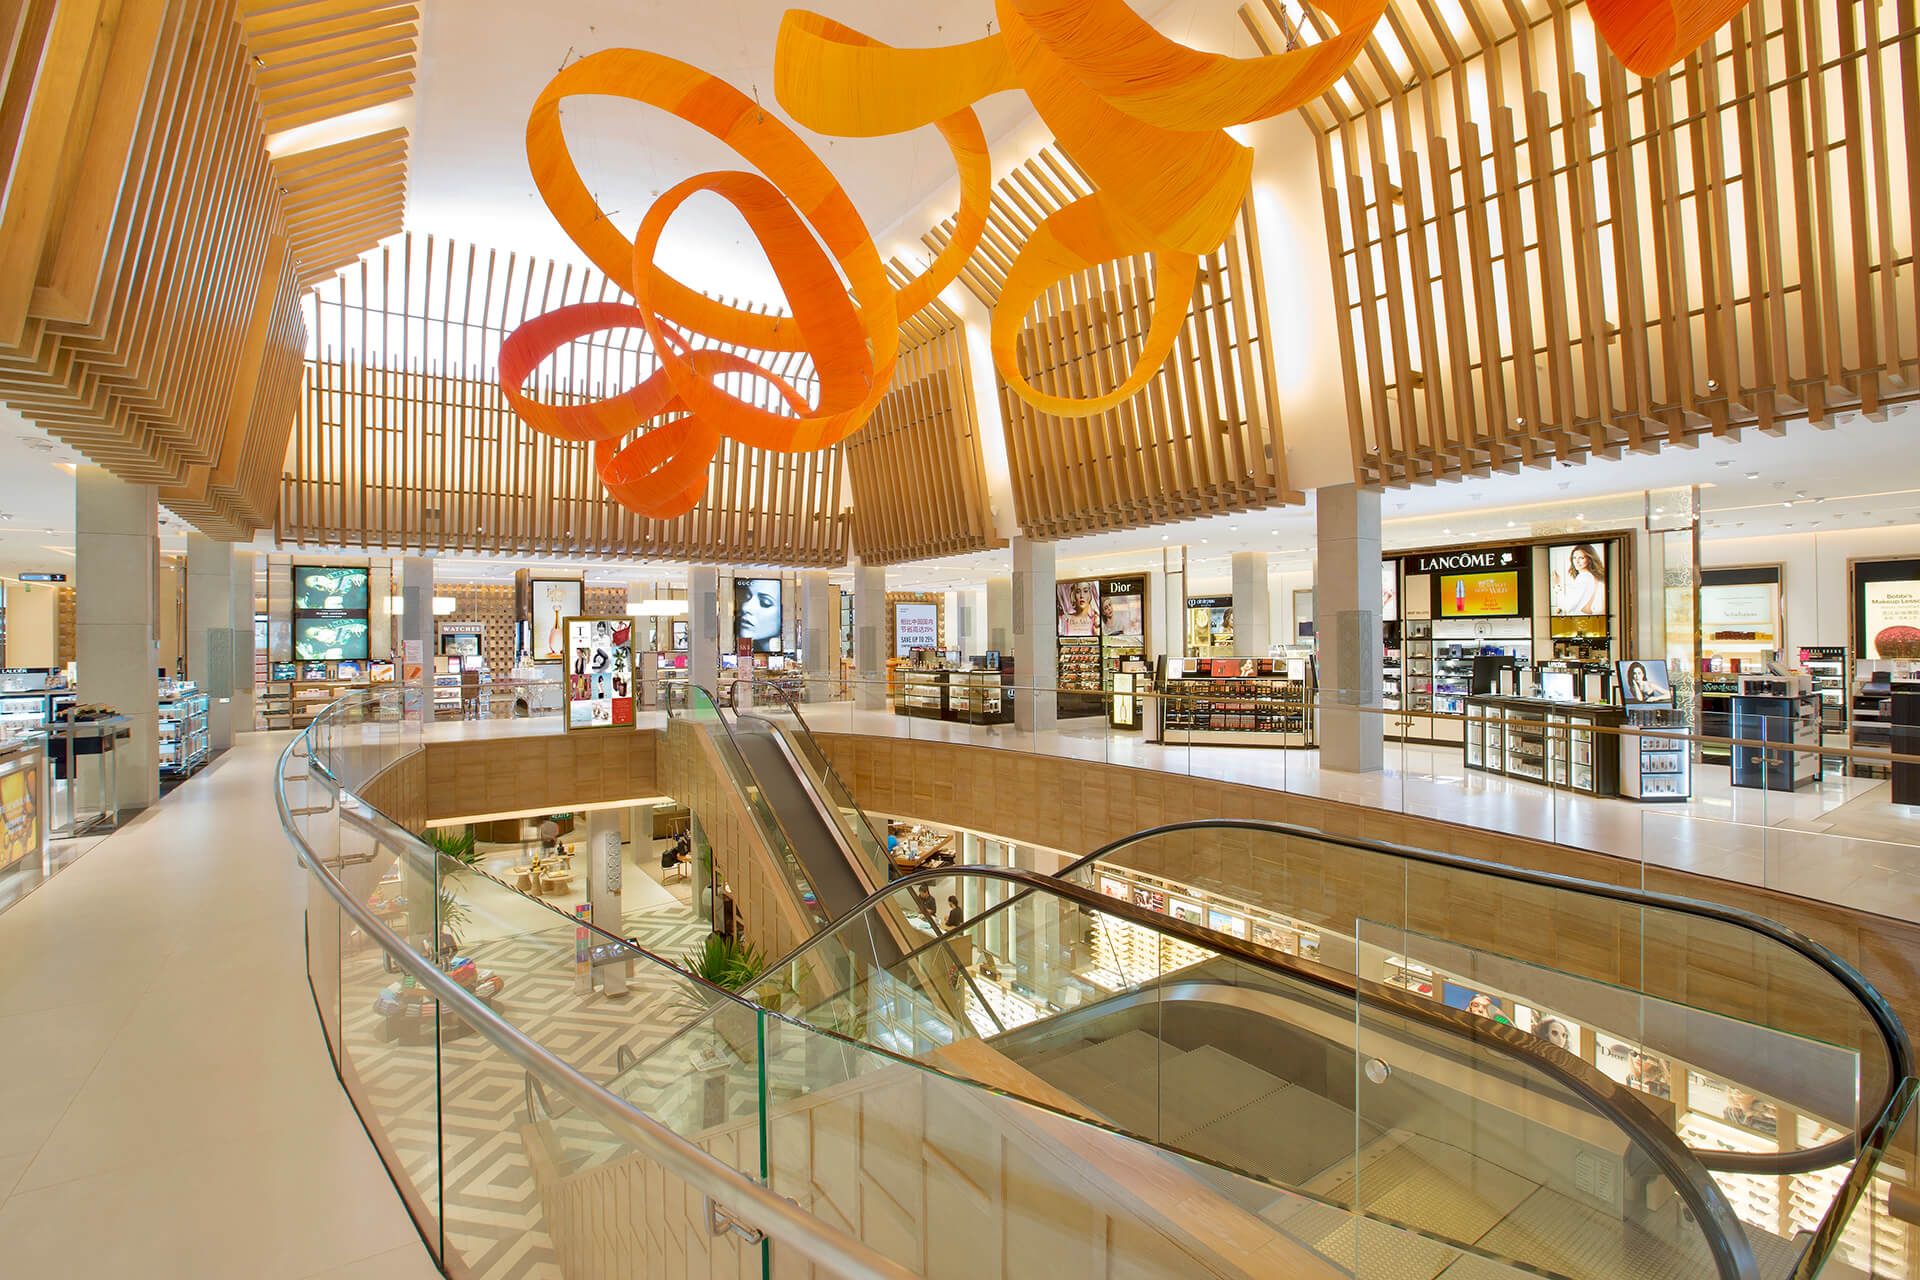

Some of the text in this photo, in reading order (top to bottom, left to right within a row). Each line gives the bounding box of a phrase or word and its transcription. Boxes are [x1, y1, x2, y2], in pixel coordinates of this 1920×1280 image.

[1420, 553, 1495, 571] LANCÔME
[1110, 582, 1132, 593] Dior
[443, 625, 481, 633] WATCHES
[1601, 1046, 1625, 1060] Dior
